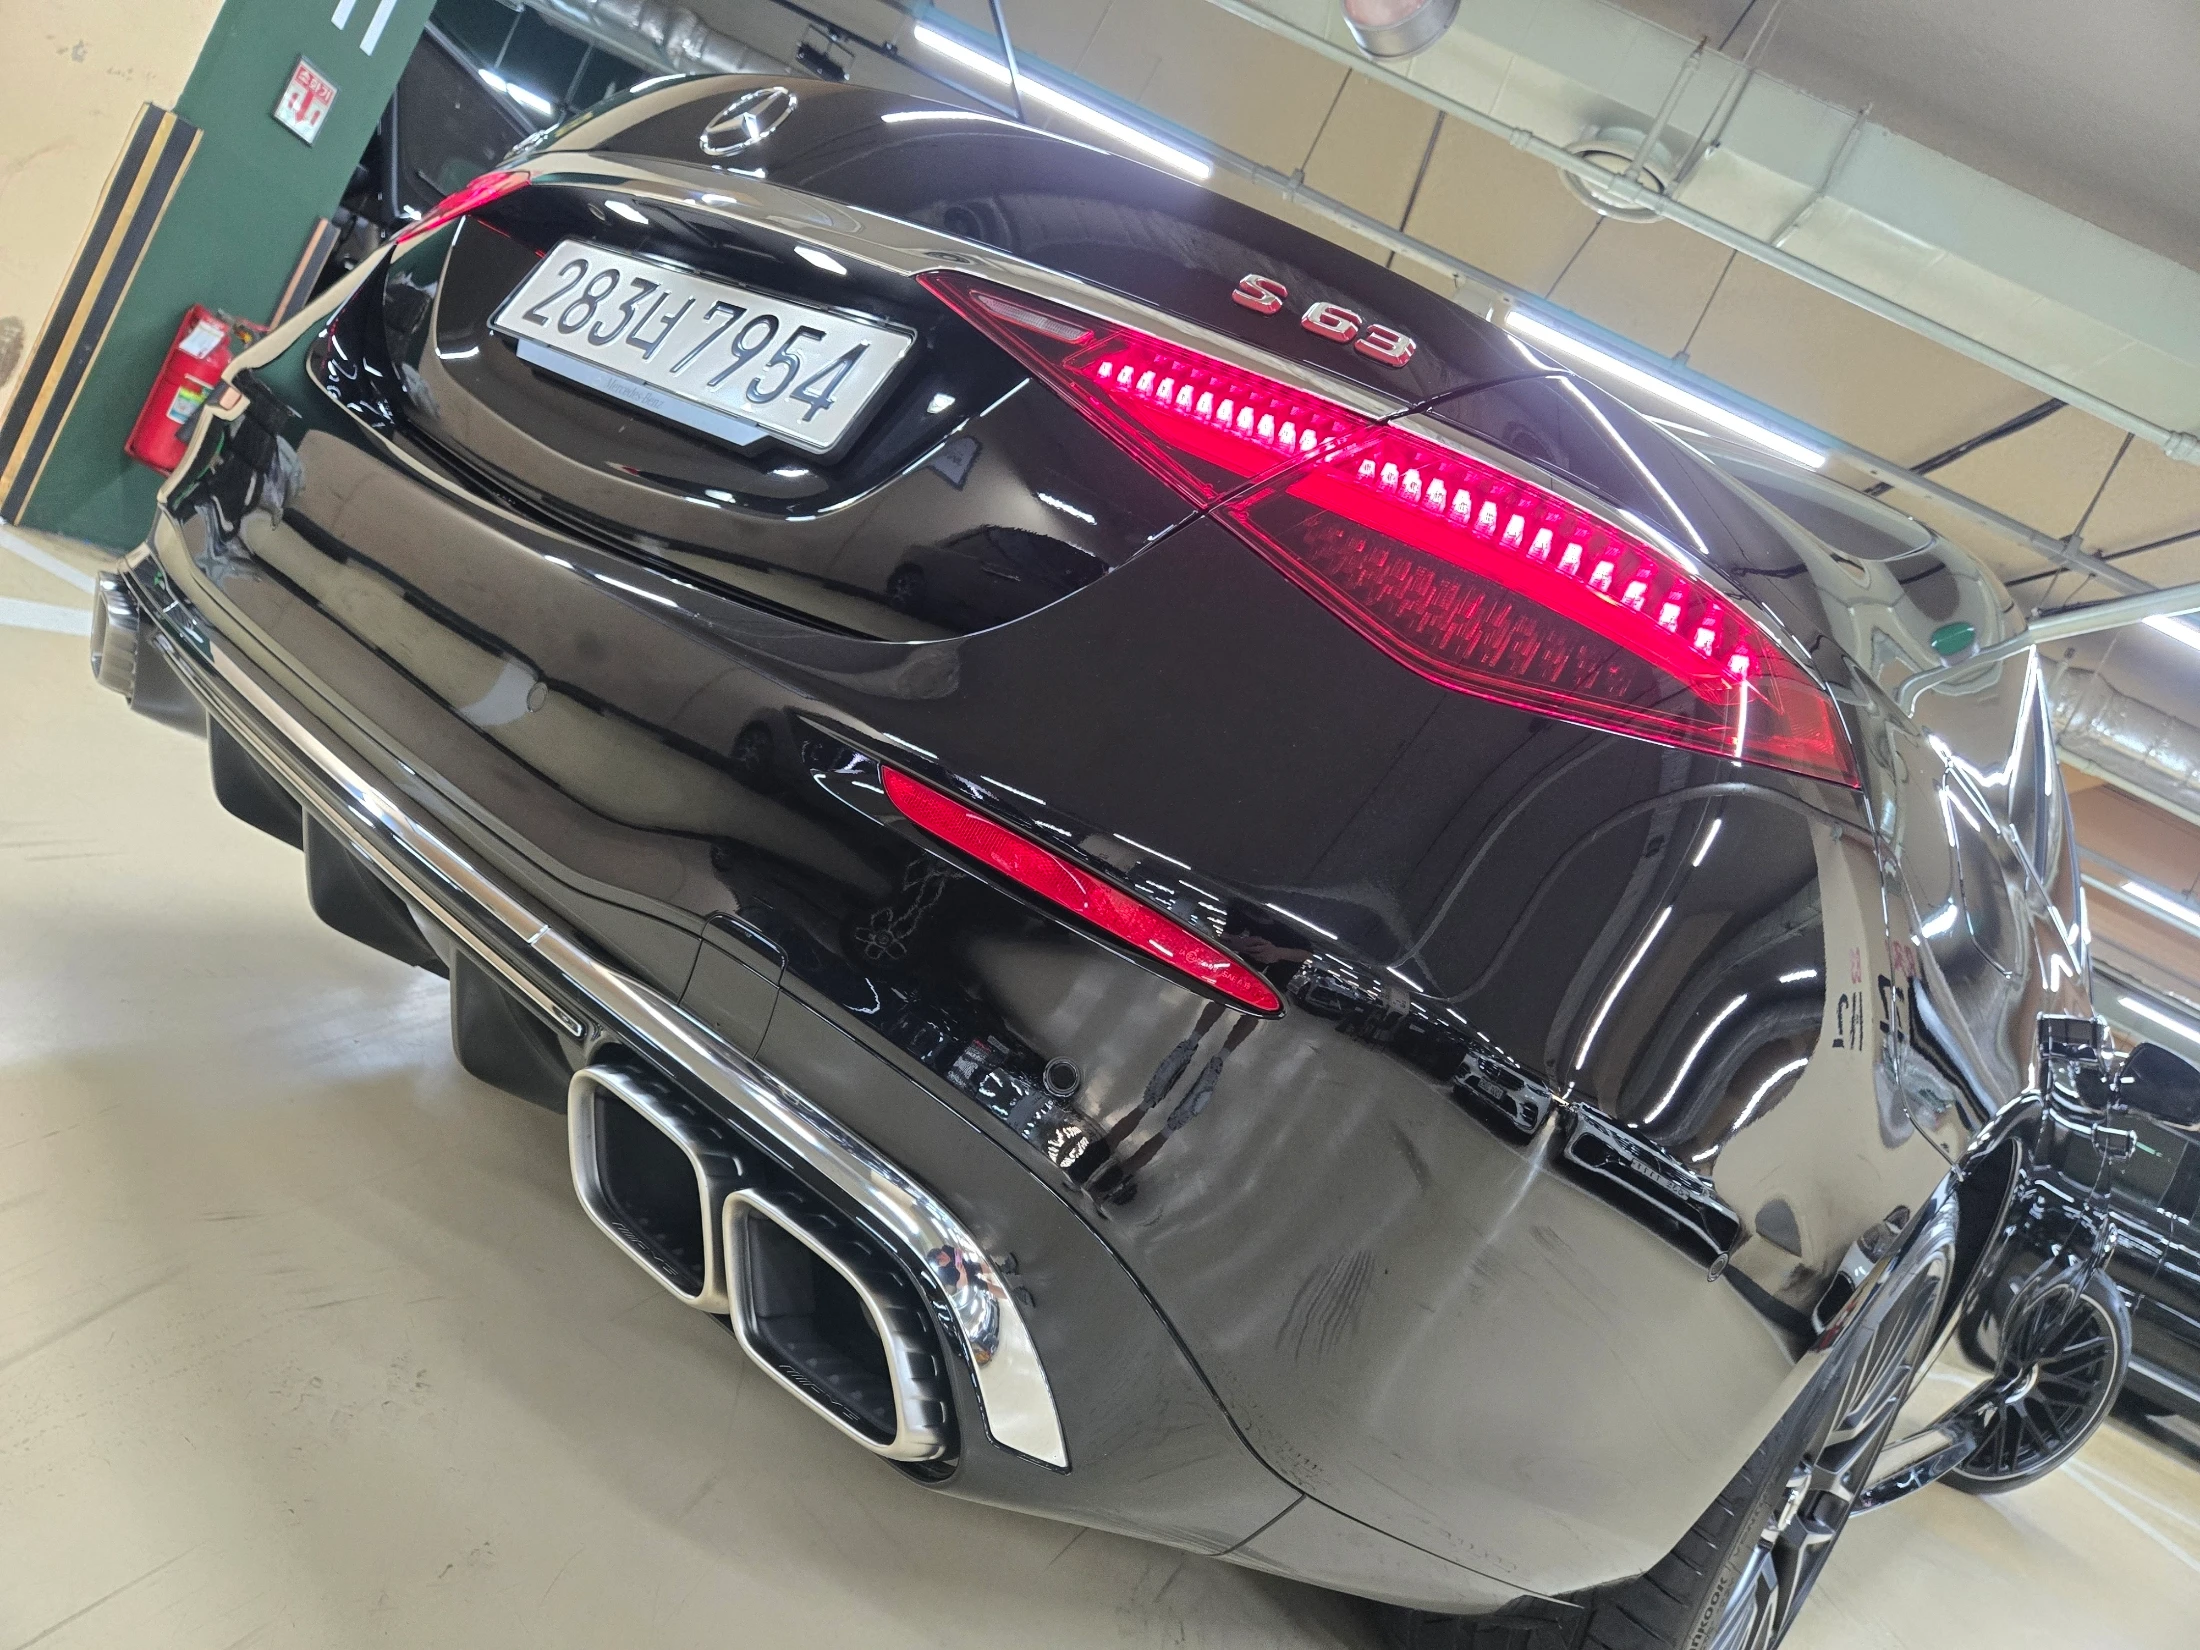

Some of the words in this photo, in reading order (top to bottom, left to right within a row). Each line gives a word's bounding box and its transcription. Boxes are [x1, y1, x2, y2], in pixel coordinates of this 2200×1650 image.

[298, 70, 331, 101] 소화기
[669, 299, 871, 421] 7954
[1231, 273, 1288, 315] S
[1301, 302, 1416, 367] 63
